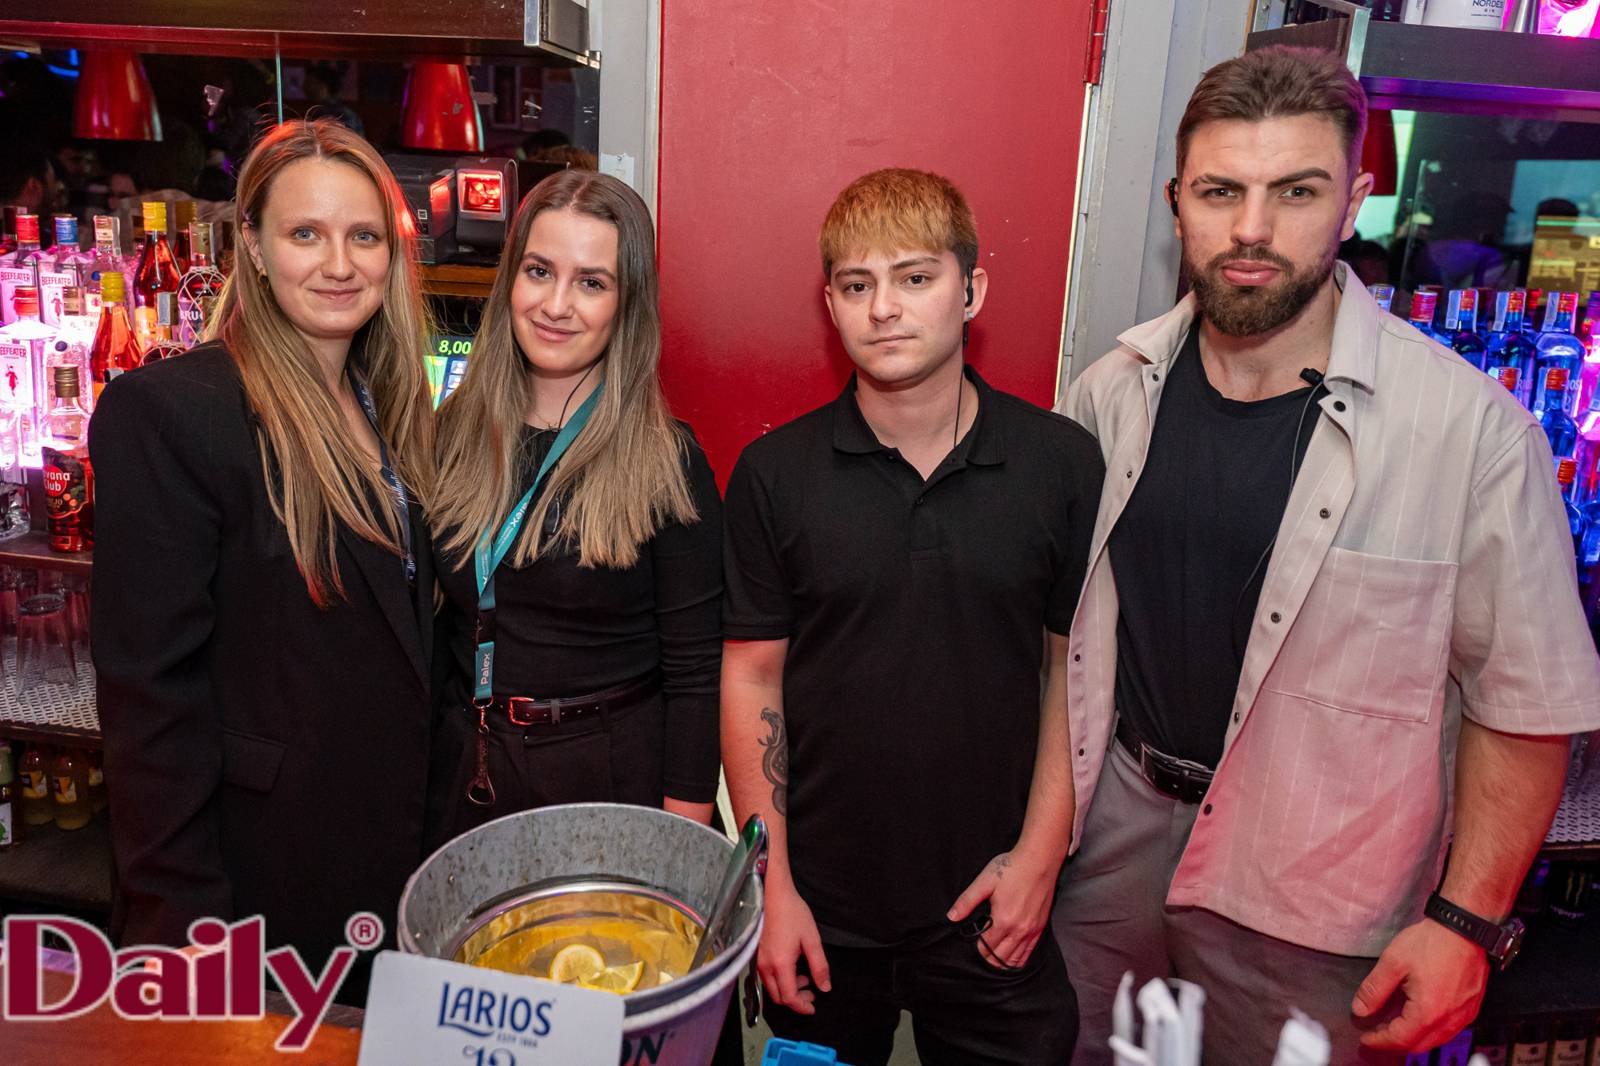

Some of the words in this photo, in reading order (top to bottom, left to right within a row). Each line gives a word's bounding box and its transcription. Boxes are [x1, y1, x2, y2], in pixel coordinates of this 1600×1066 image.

[0, 271, 31, 282] BEEFEATER
[41, 276, 71, 286] BEEFEATER
[0, 346, 26, 357] EEFEATER
[438, 339, 472, 355] 8,00
[480, 652, 491, 685] Palex
[438, 981, 553, 1037] LARIOS
